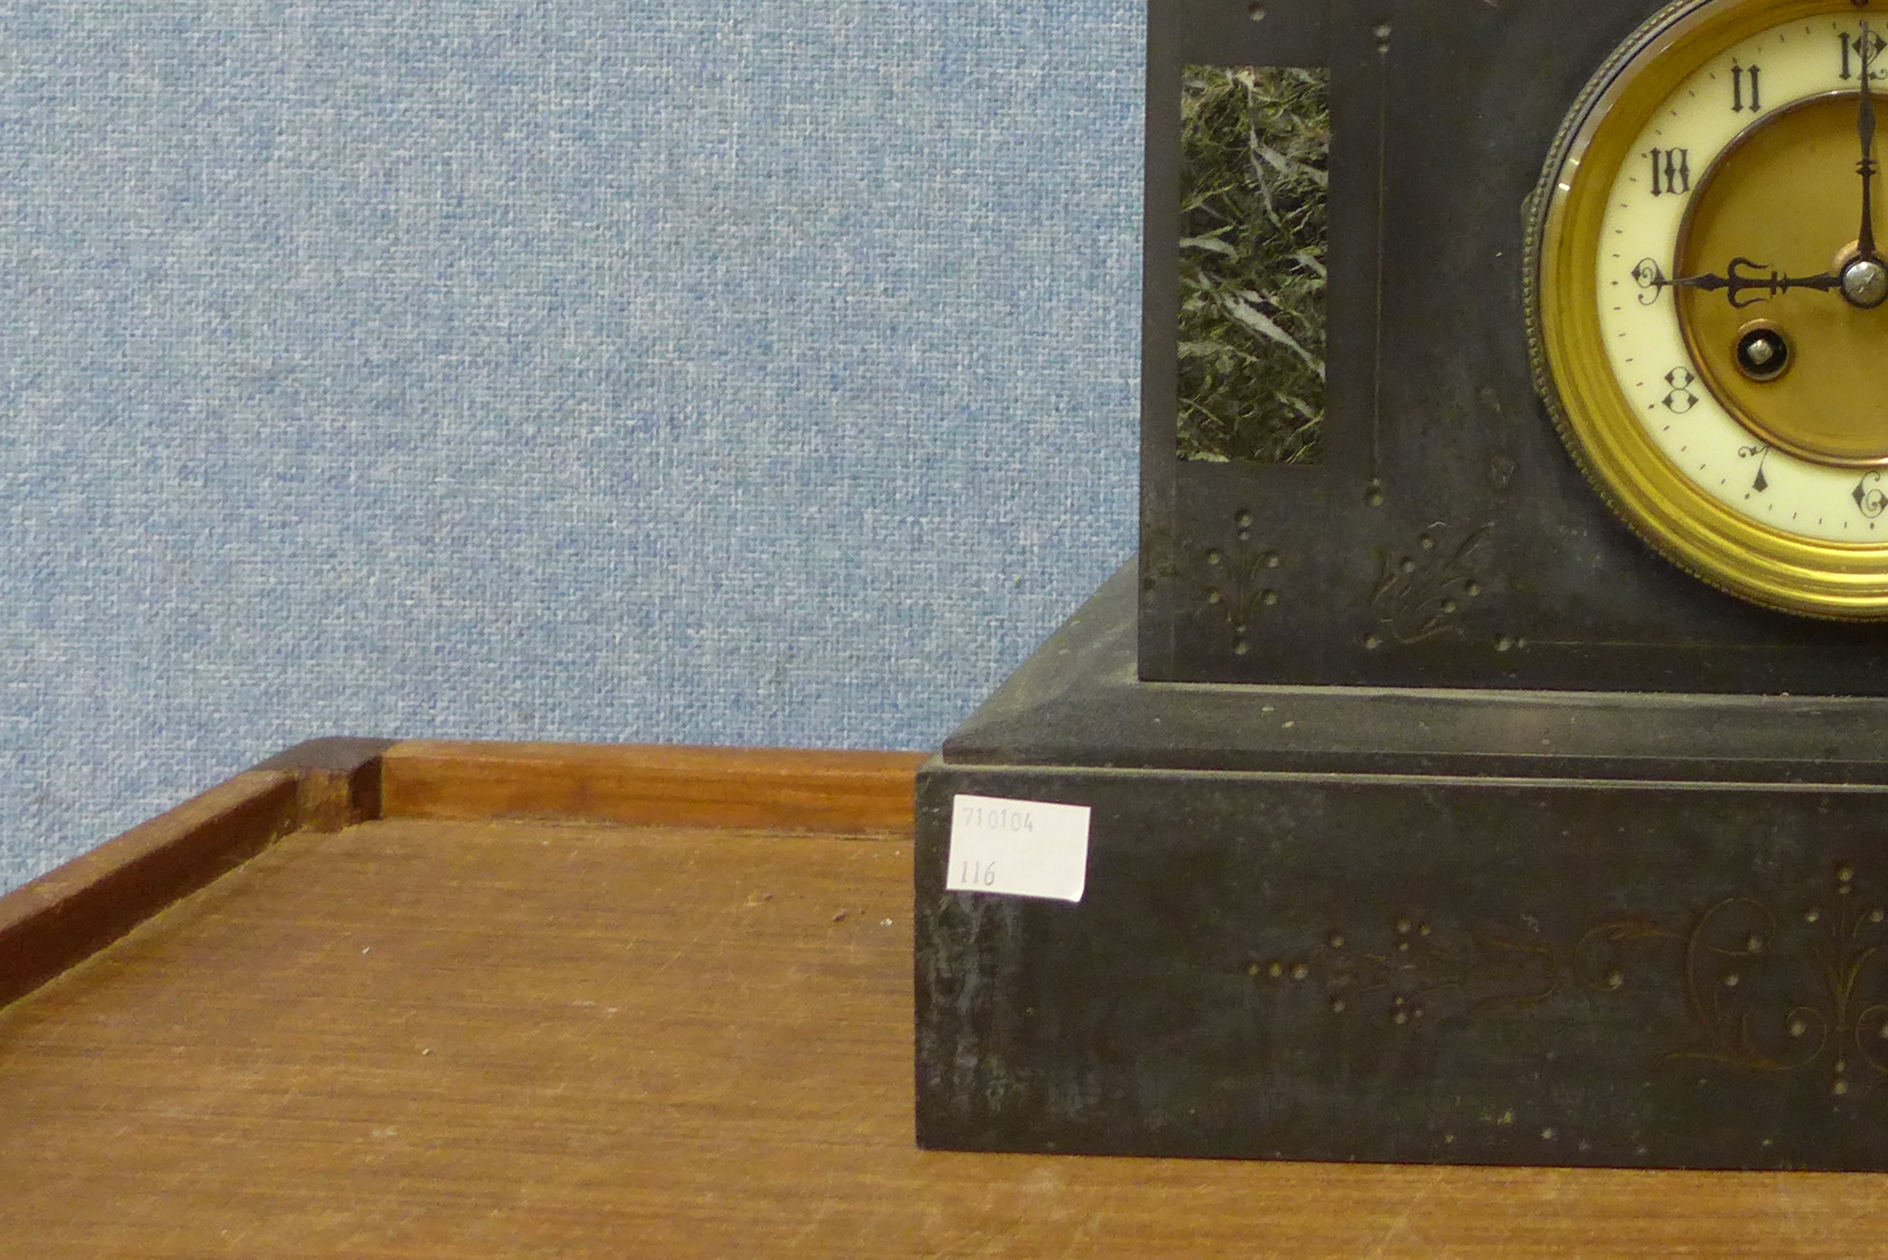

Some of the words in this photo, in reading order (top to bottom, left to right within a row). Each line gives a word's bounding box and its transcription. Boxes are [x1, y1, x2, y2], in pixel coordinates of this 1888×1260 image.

[1838, 30, 1888, 81] 12
[1731, 63, 1761, 113] 11
[1648, 146, 1691, 197] 10
[1631, 257, 1667, 306] 9
[1661, 366, 1699, 414] 8
[1737, 444, 1769, 492] 7
[1852, 470, 1888, 518] 6
[960, 859, 996, 886] 116
